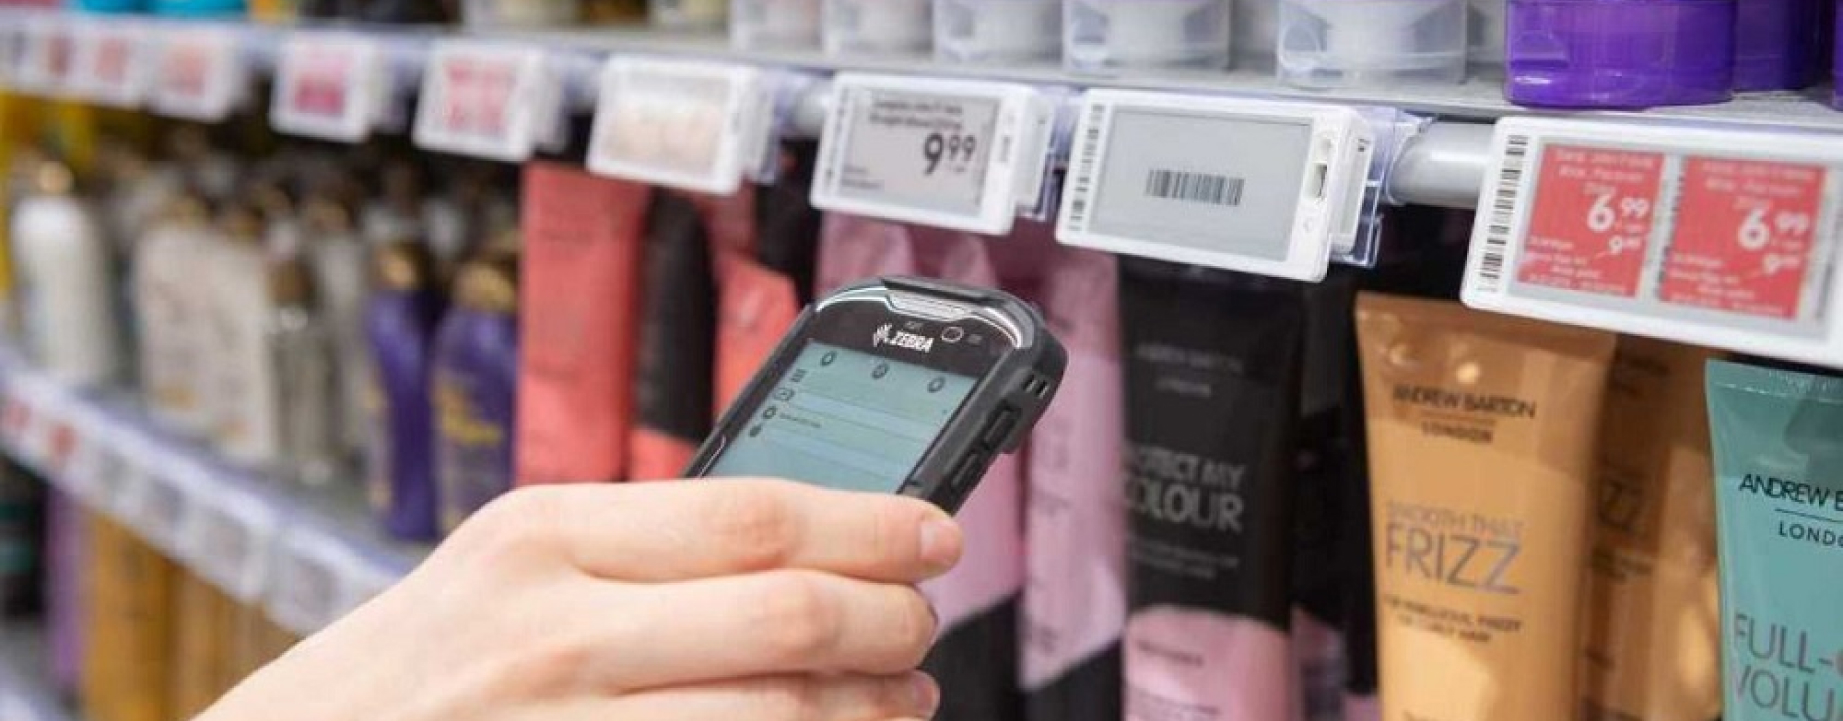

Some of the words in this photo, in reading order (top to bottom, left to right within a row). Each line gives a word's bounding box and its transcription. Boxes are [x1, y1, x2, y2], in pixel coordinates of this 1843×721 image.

[892, 329, 934, 354] ZEBRA
[1201, 459, 1247, 490] MY
[1737, 473, 1831, 507] ANDREW
[1386, 520, 1523, 595] FRIZZ
[1733, 612, 1843, 677] FULL-
[1735, 664, 1843, 721] VOLU
